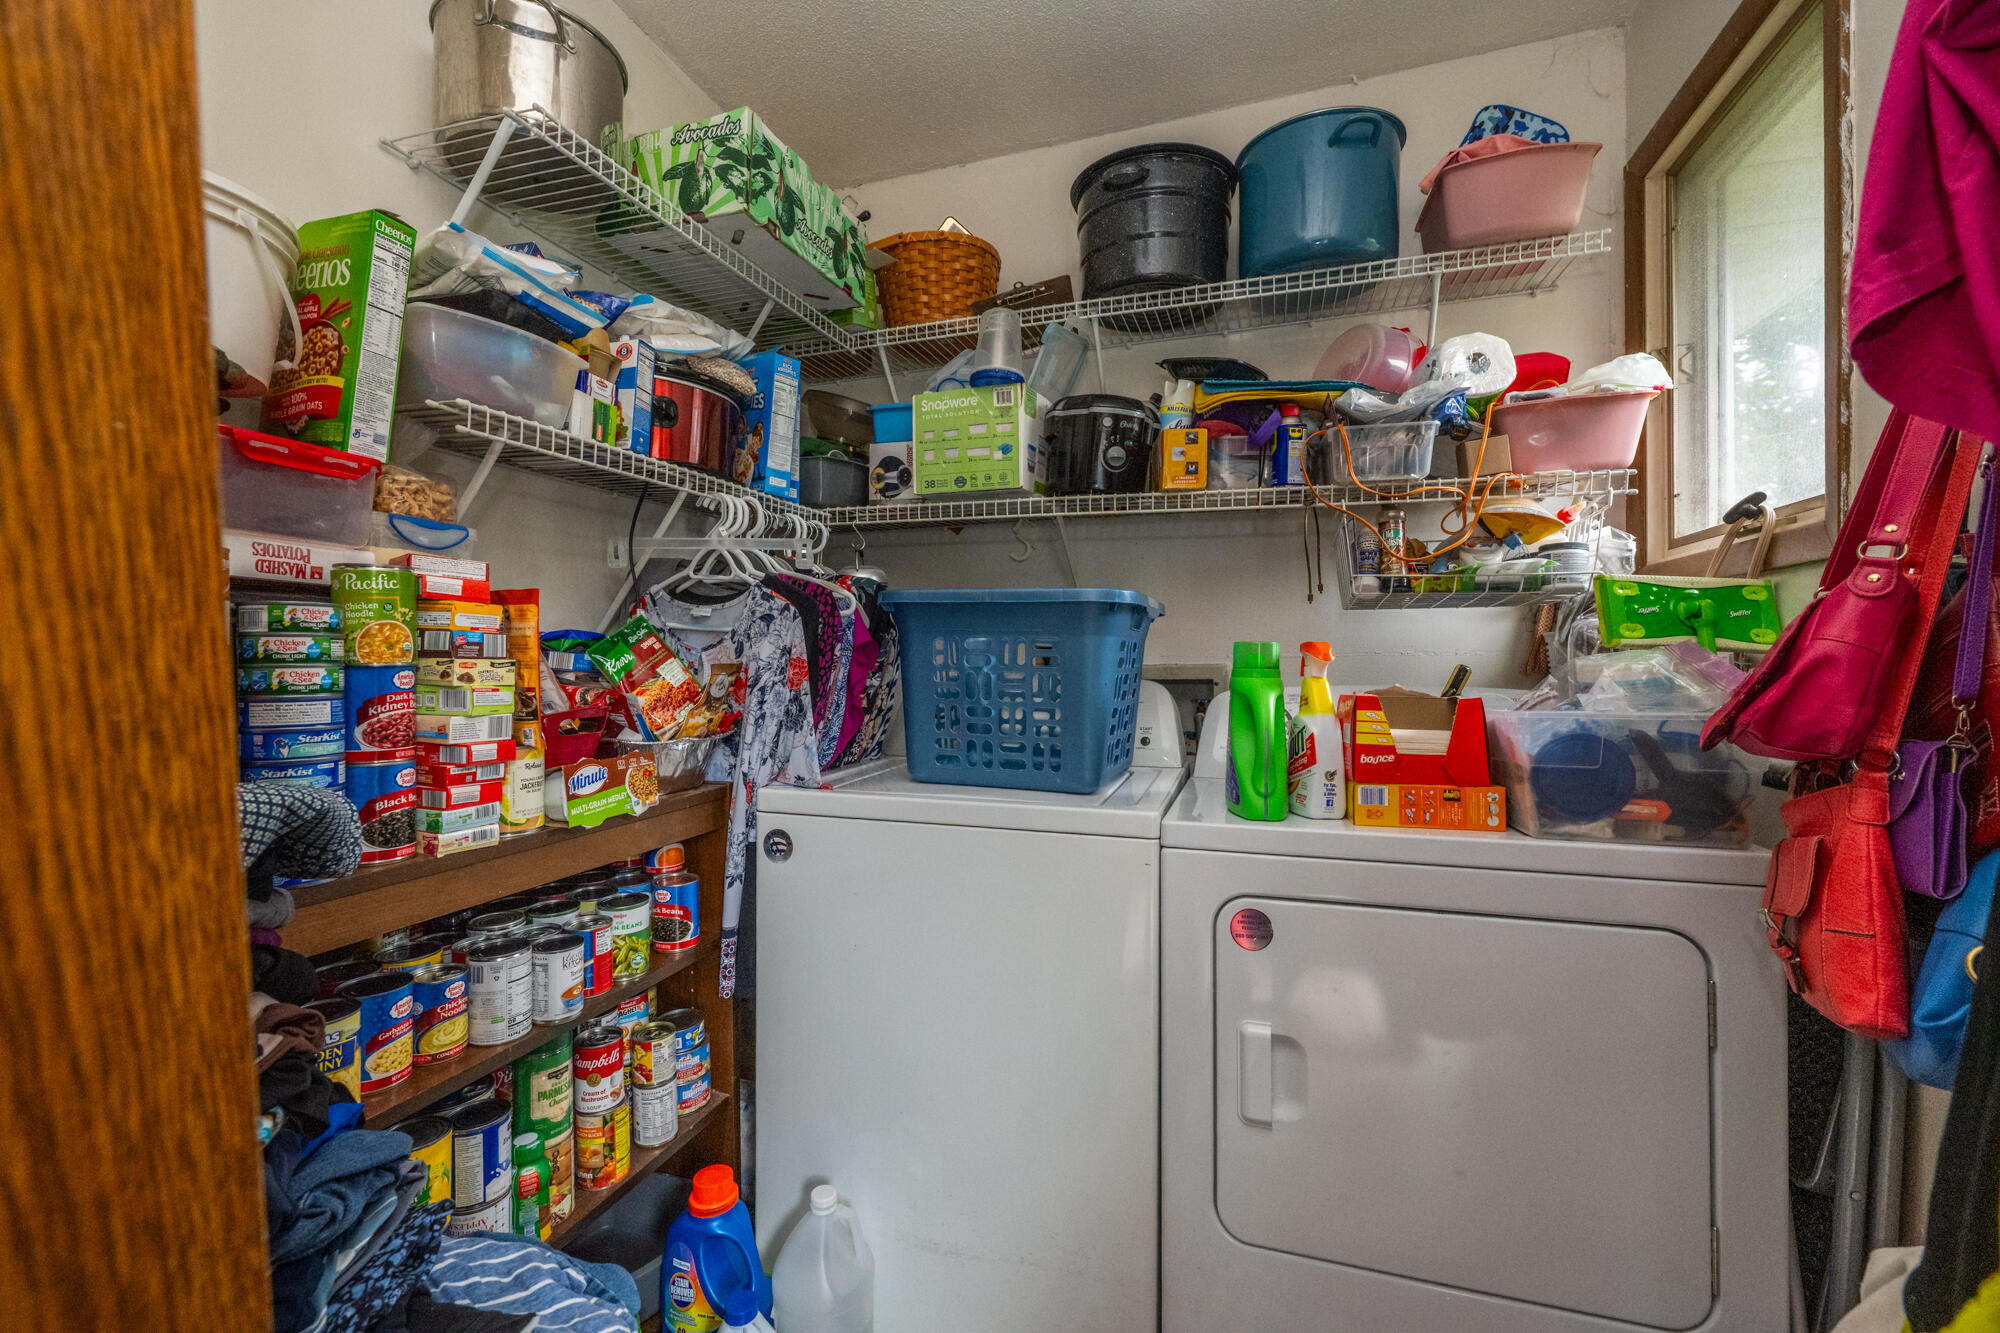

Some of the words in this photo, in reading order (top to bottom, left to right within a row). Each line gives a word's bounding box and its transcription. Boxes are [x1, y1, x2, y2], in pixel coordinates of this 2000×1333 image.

[671, 115, 741, 146] Avocados
[375, 219, 412, 245] Cheerios
[289, 258, 351, 292] eerios
[306, 401, 323, 410] OATS
[921, 396, 978, 412] Snapware
[924, 479, 937, 489] 38
[251, 541, 312, 565] POTATOES
[254, 558, 307, 579] MASHED
[340, 572, 400, 592] Pacific
[301, 607, 330, 615] Chicken
[344, 602, 379, 611] Chicken
[345, 610, 375, 618] Noodle
[273, 639, 306, 647] Chicken
[605, 653, 634, 675] Knorr
[386, 693, 408, 703] Dark
[368, 700, 409, 716] Kidney
[297, 732, 340, 744] StarKist
[1360, 754, 1395, 764] bounce
[260, 767, 314, 779] StarKist
[568, 766, 608, 795] Minute
[375, 795, 407, 811] Black
[571, 800, 607, 816] MULTI-GRAIN
[621, 921, 643, 931] BEANS
[437, 996, 468, 1013] Chicke
[317, 1045, 343, 1063] DEN
[316, 1056, 344, 1073] INY
[674, 1277, 689, 1287] STAIN
[670, 1285, 694, 1298] REMOVER
